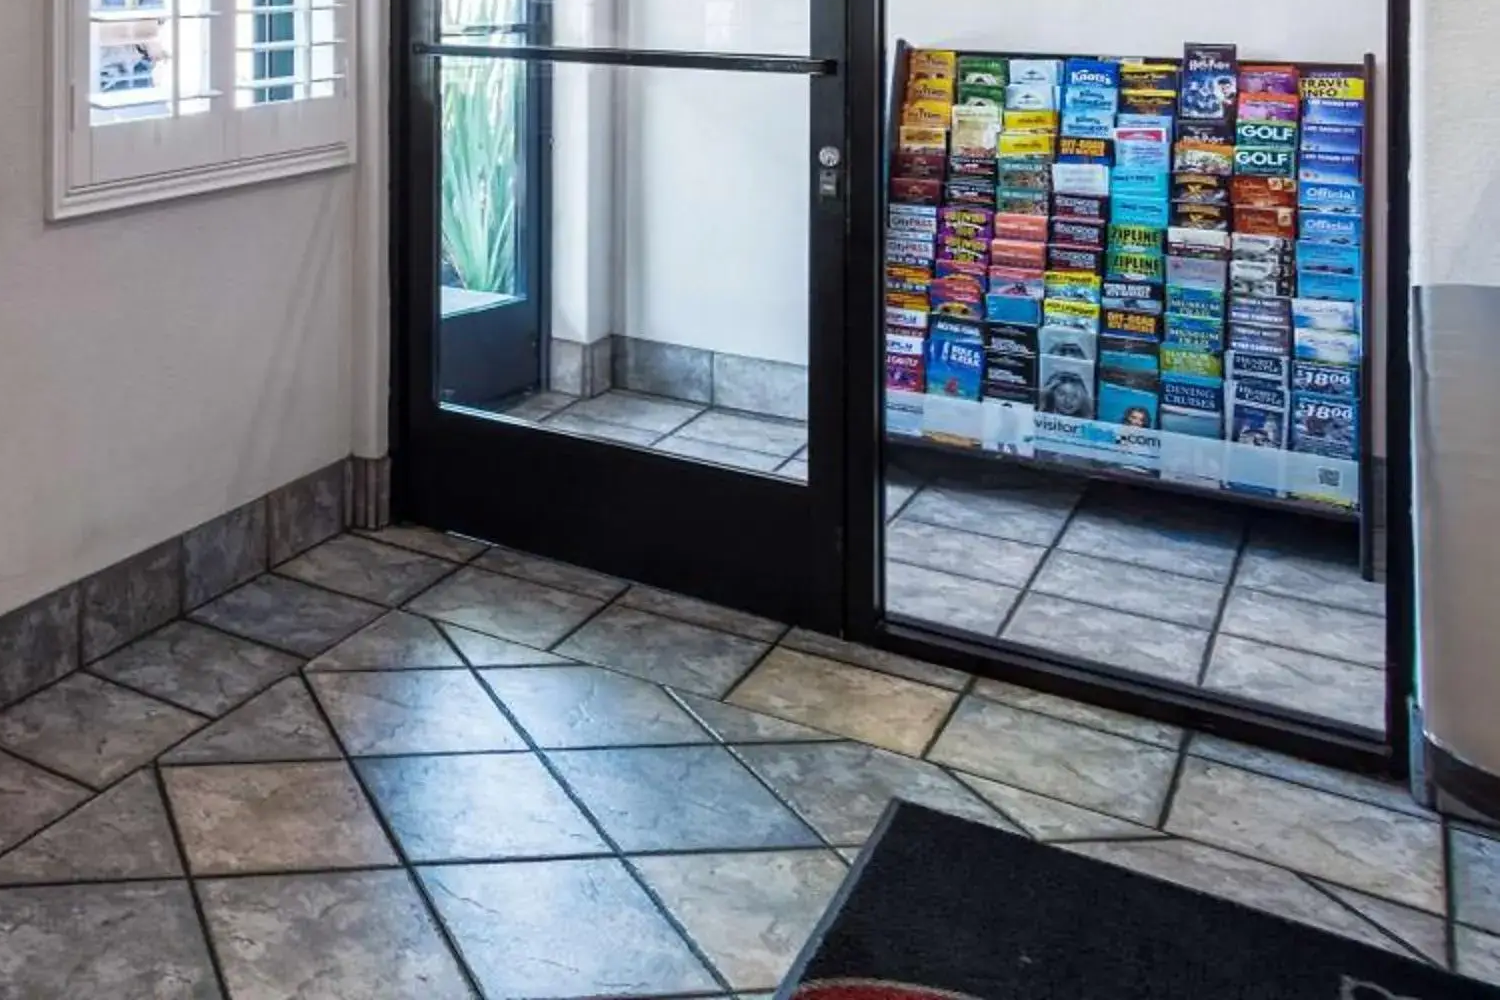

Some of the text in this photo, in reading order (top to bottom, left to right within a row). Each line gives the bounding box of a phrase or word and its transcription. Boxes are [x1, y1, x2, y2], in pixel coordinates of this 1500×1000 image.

[1300, 78, 1350, 89] TRAVEL
[1302, 88, 1338, 98] INFO
[1241, 125, 1294, 141] GOLF
[1235, 151, 1288, 166] GOLF
[1306, 187, 1356, 200] Official
[1305, 219, 1355, 231] Official
[1112, 228, 1161, 243] ZIPLINE
[1114, 254, 1161, 269] ZIPLINE
[1165, 395, 1216, 408] CRUISES
